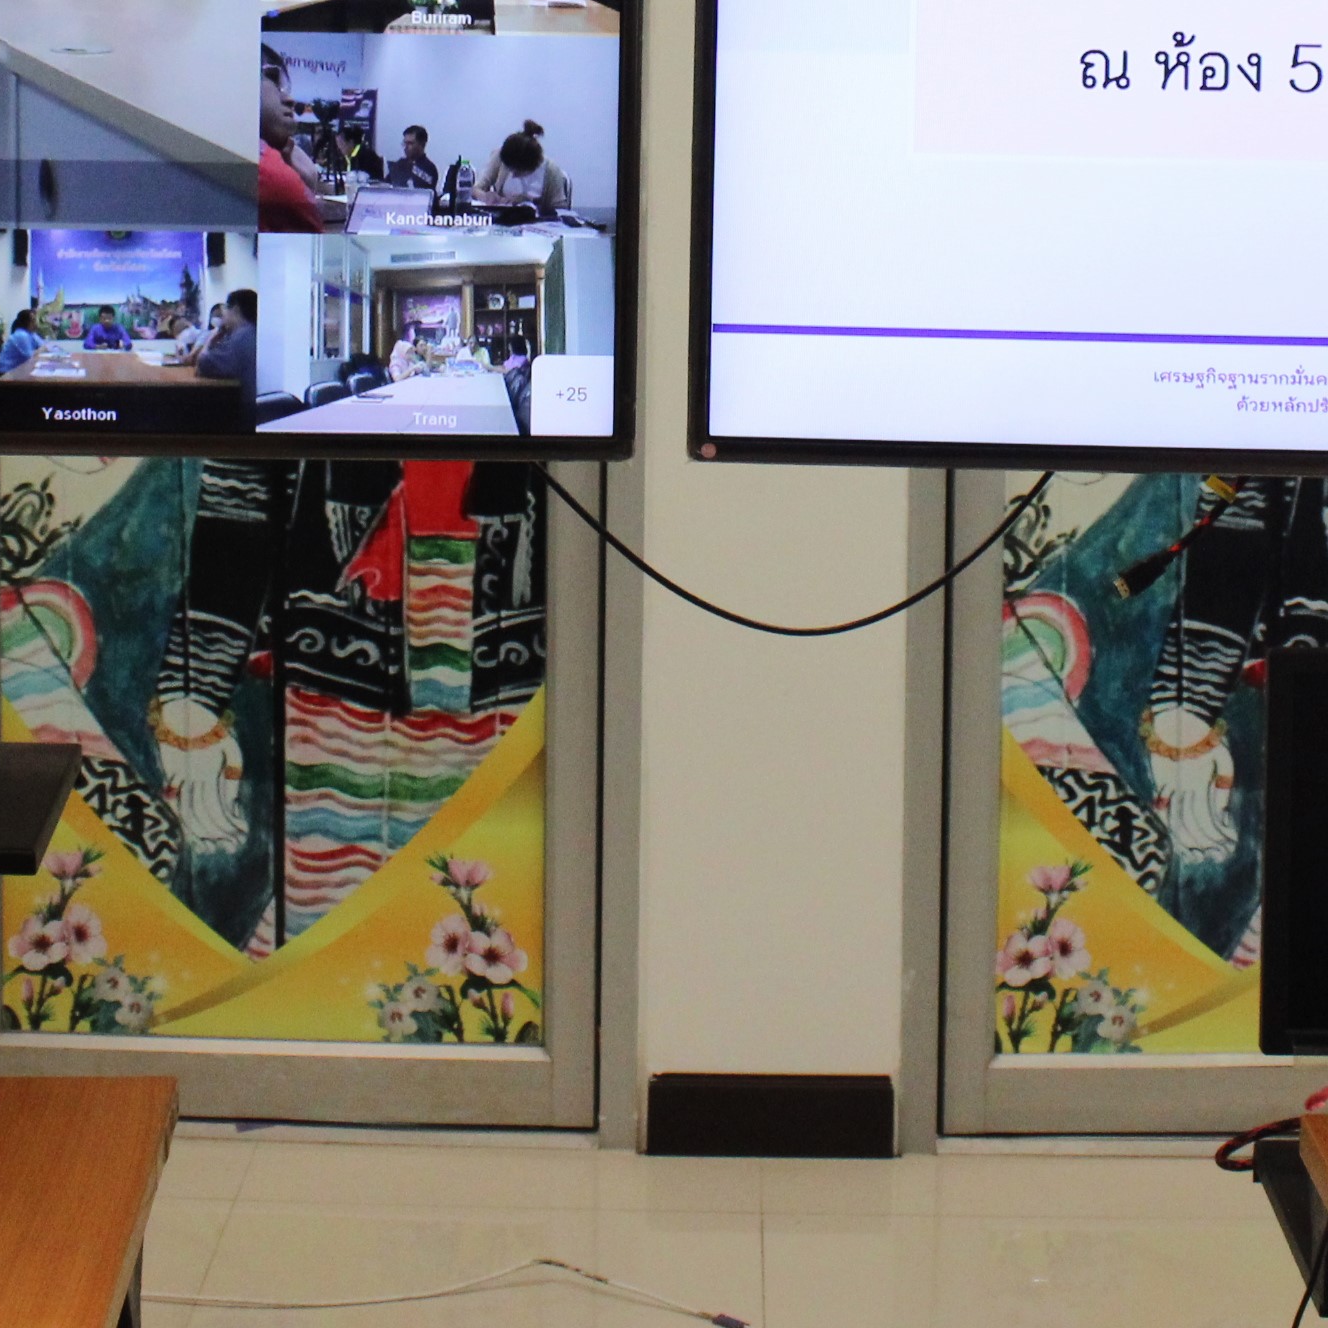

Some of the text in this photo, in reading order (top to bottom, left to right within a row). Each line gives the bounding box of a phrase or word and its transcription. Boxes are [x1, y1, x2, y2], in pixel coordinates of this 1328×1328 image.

[411, 11, 472, 25] Buriram
[1080, 49, 1130, 90] ณ
[1155, 31, 1262, 92] ห้อง
[385, 211, 493, 227] Kanchanaburi
[555, 387, 588, 402] +25
[41, 406, 117, 421] Yasothon
[413, 412, 457, 428] Trang
